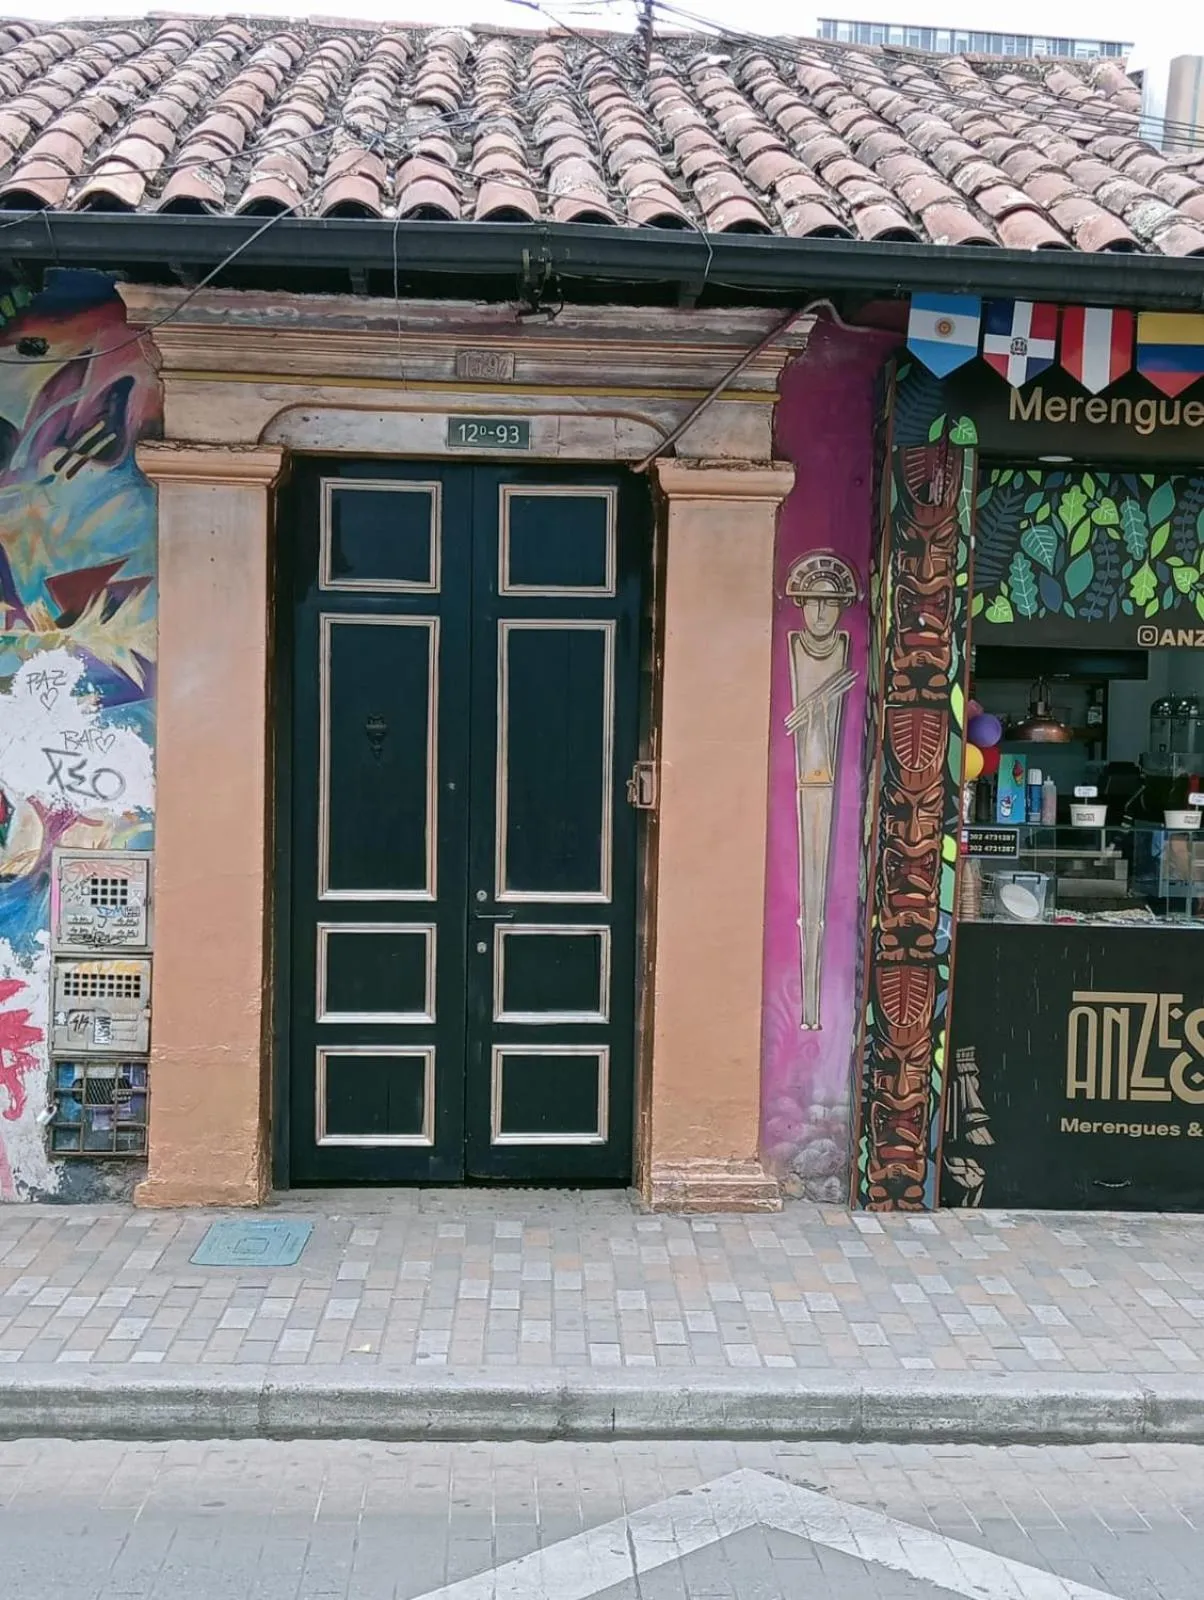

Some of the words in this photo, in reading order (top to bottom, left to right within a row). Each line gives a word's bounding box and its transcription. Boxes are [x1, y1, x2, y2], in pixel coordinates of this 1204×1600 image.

[1009, 386, 1204, 435] Merengue
[26, 670, 67, 695] PAZ
[1060, 1117, 1181, 1138] Merengues
[1187, 1121, 1204, 1137] &
